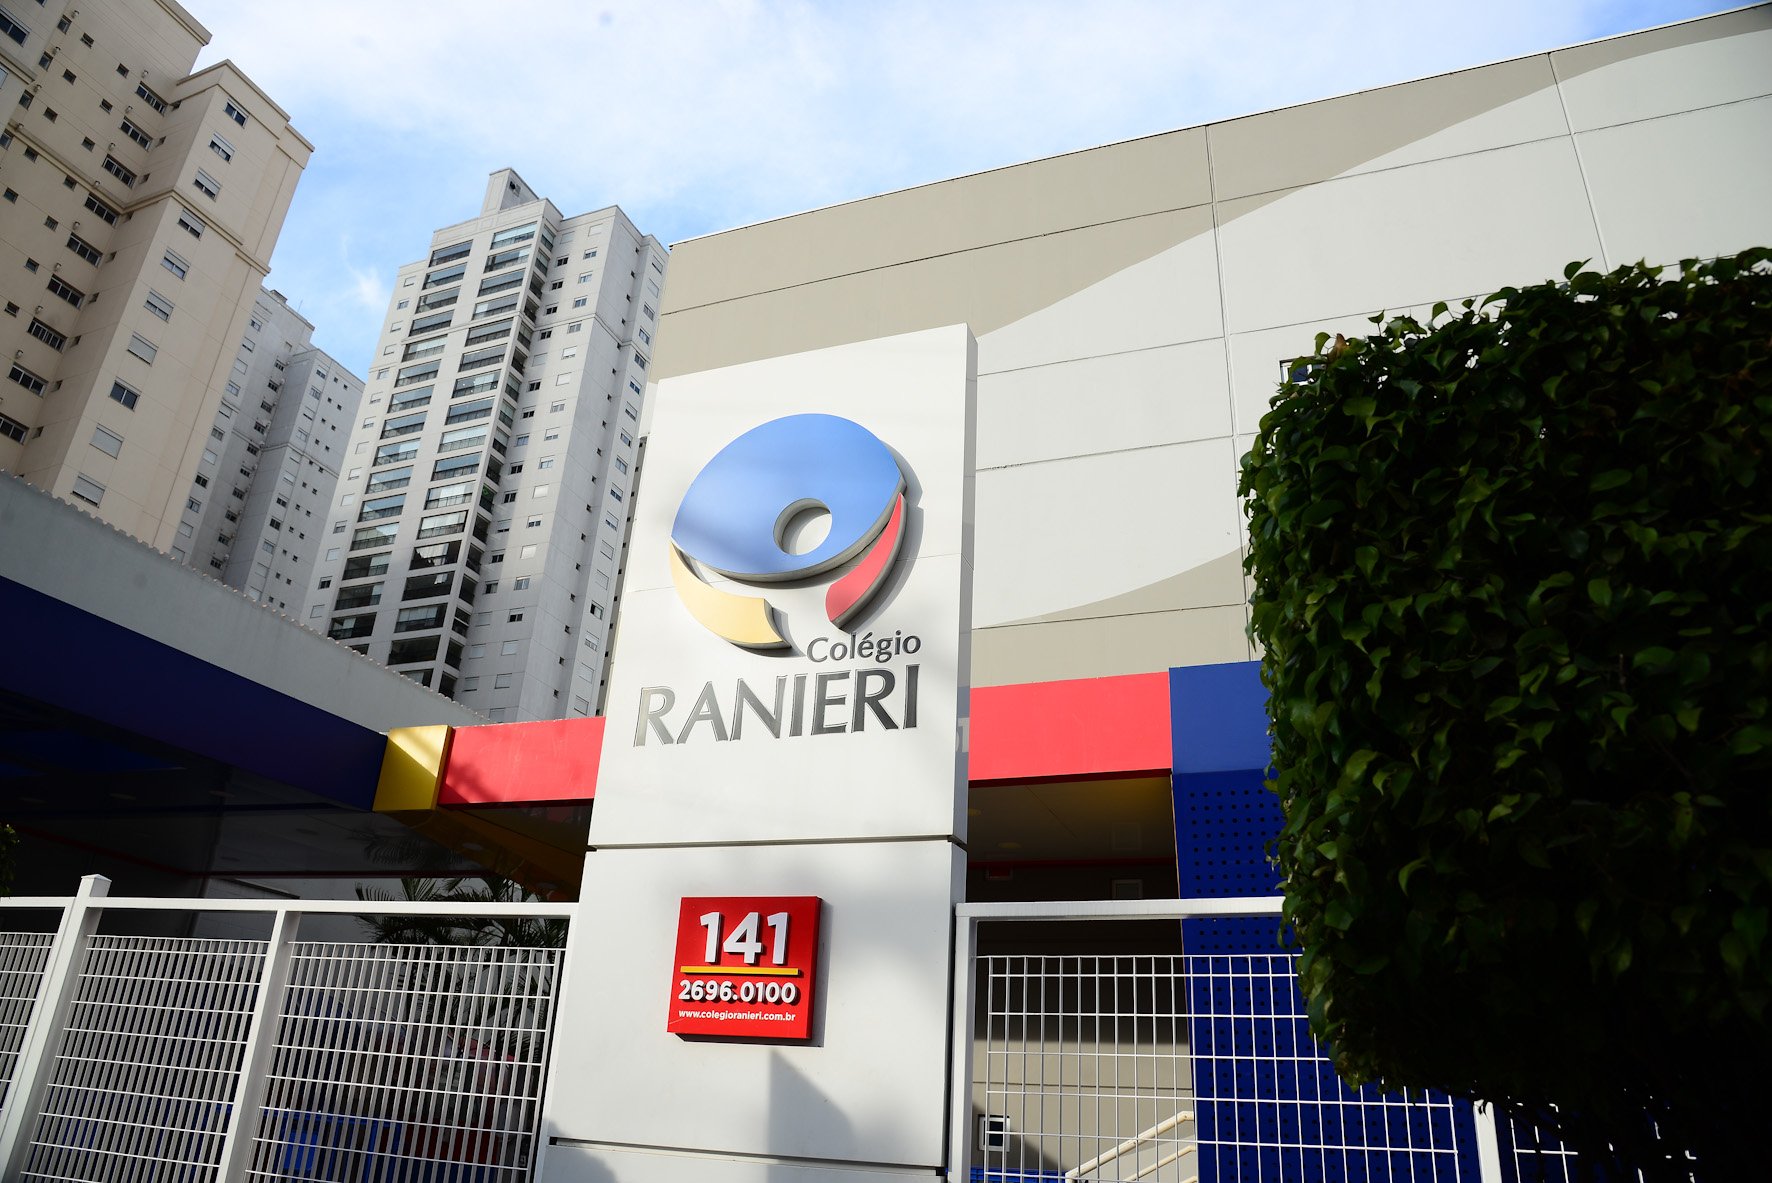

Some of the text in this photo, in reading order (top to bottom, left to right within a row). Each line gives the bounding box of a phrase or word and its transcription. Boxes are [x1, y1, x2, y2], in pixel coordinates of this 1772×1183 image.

[807, 630, 921, 663] Colégio
[633, 664, 920, 747] RANIERI
[700, 912, 788, 964] 141
[678, 980, 796, 1003] 2696.0100
[678, 1010, 796, 1021] www.colegioranieri.com.br
